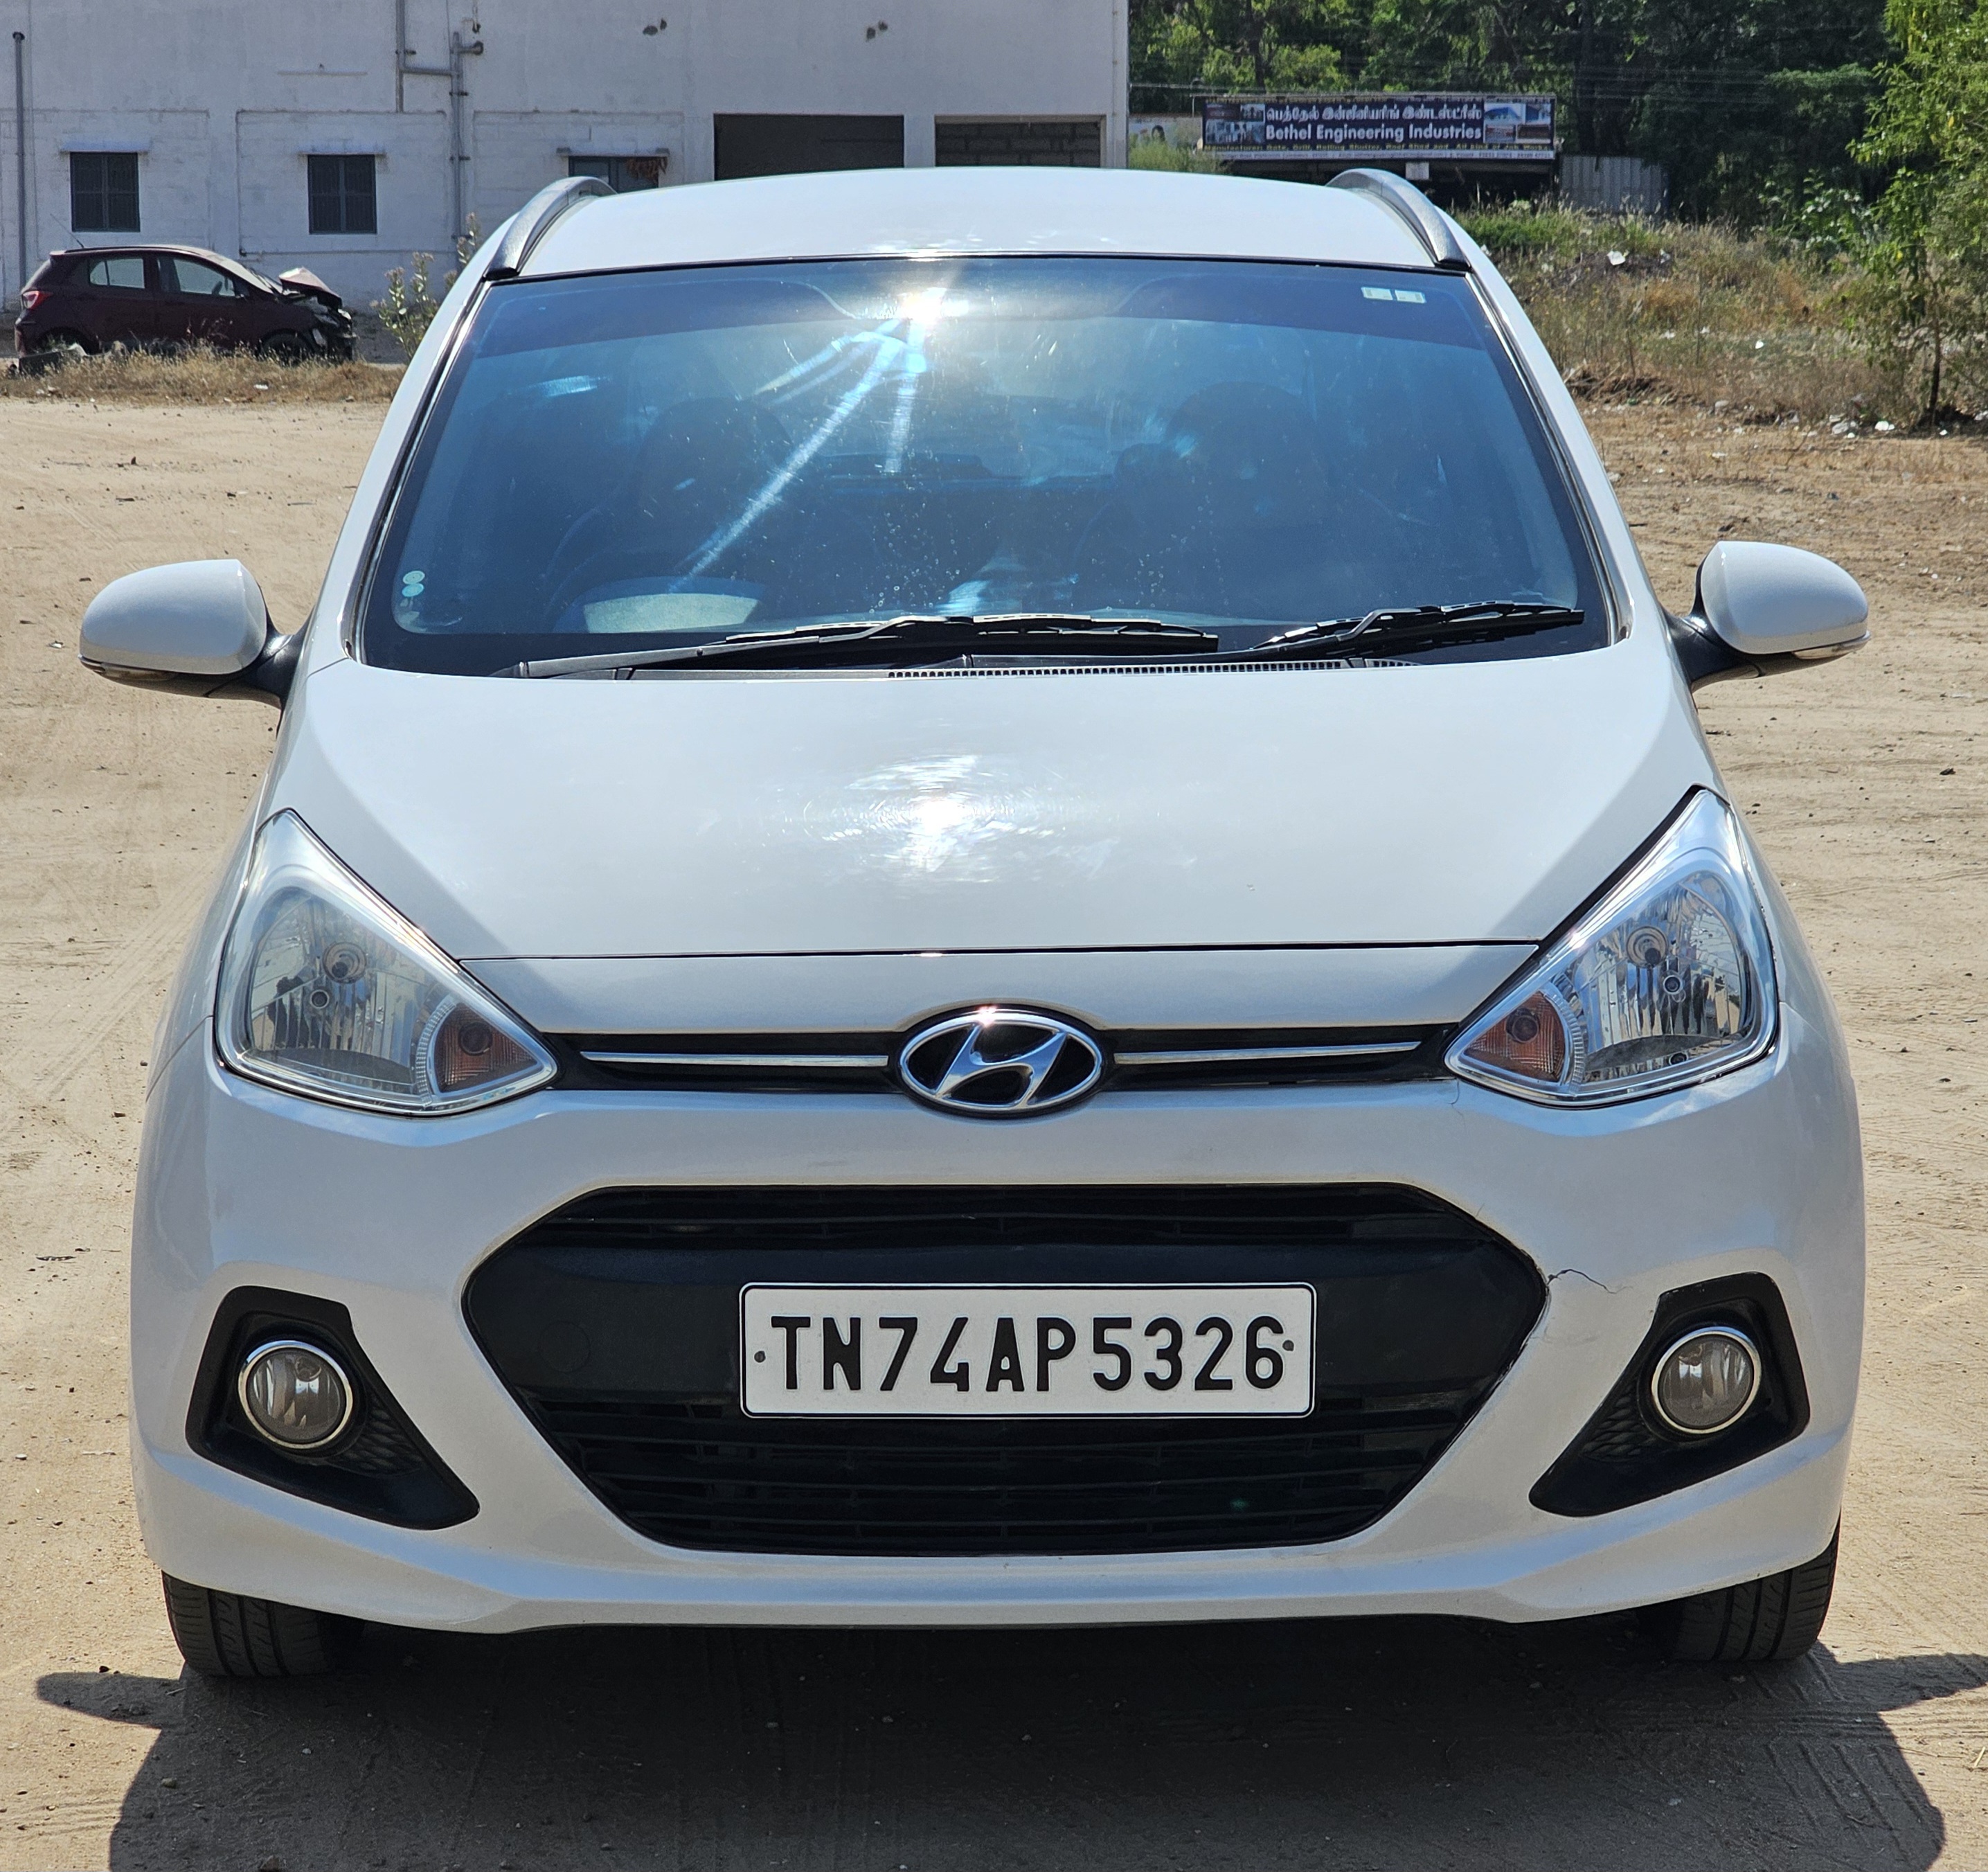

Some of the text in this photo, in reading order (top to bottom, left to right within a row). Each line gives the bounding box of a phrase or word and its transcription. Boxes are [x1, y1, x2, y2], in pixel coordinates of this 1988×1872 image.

[1266, 122, 1482, 143] Bethel Engineering Industries
[770, 1315, 1285, 1393] TN74AP5326
